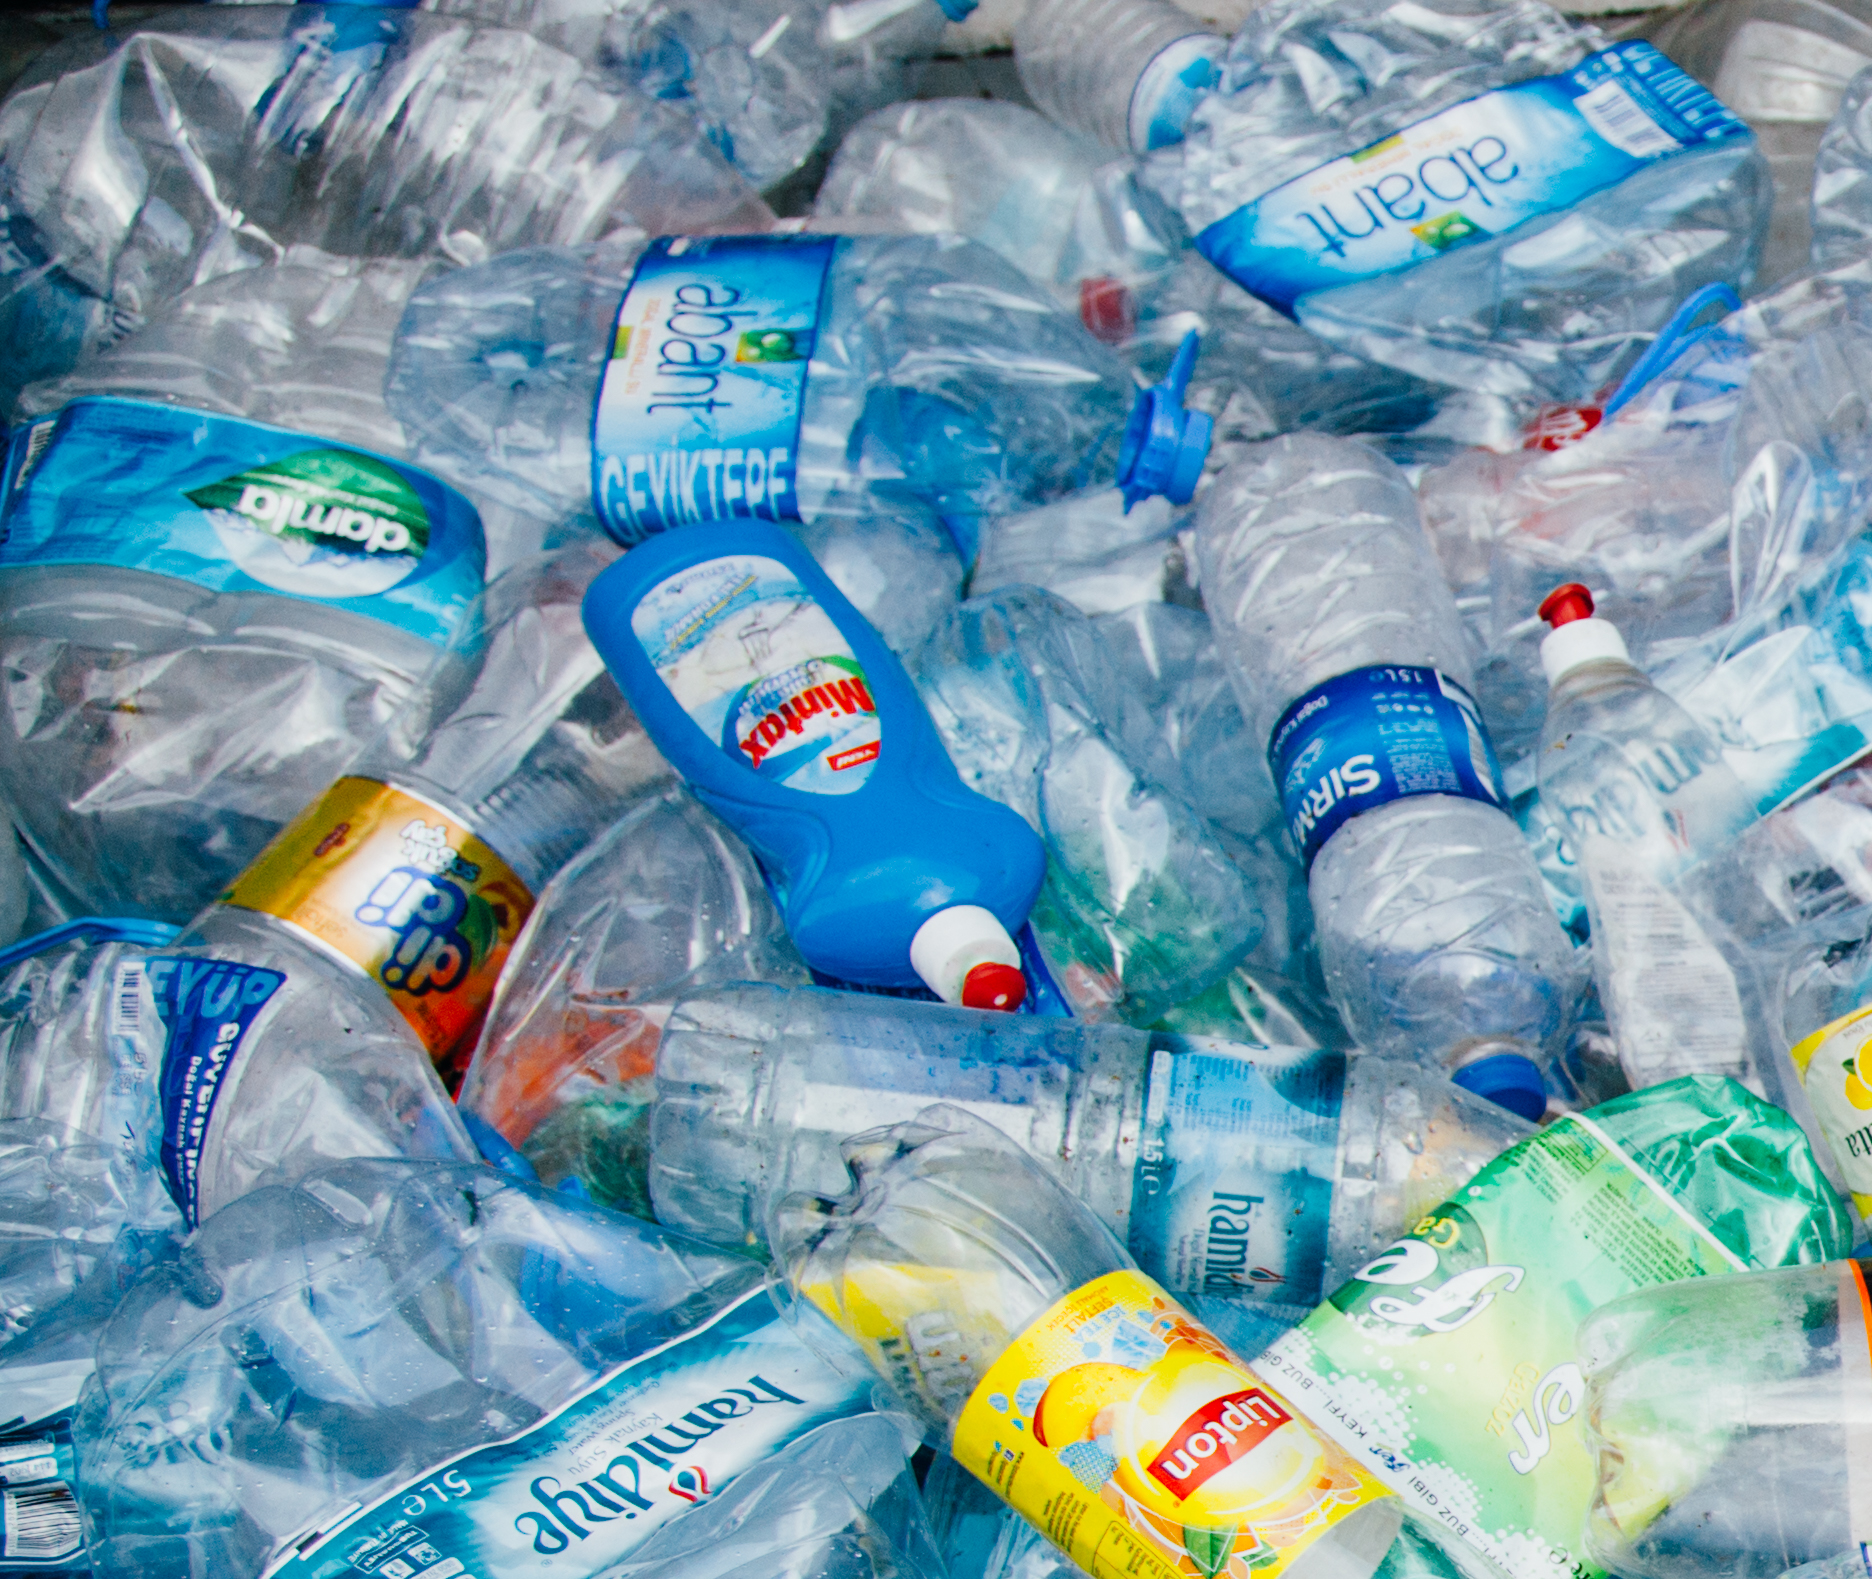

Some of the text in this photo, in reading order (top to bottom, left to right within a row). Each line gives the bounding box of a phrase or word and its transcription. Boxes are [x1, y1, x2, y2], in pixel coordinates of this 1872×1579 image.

[1296, 137, 1519, 258] abant
[653, 284, 742, 415] abant
[238, 482, 412, 554] damla
[738, 674, 878, 768] Mintax
[515, 1373, 804, 1557] hamidiye
[1161, 1393, 1284, 1480] Lipton
